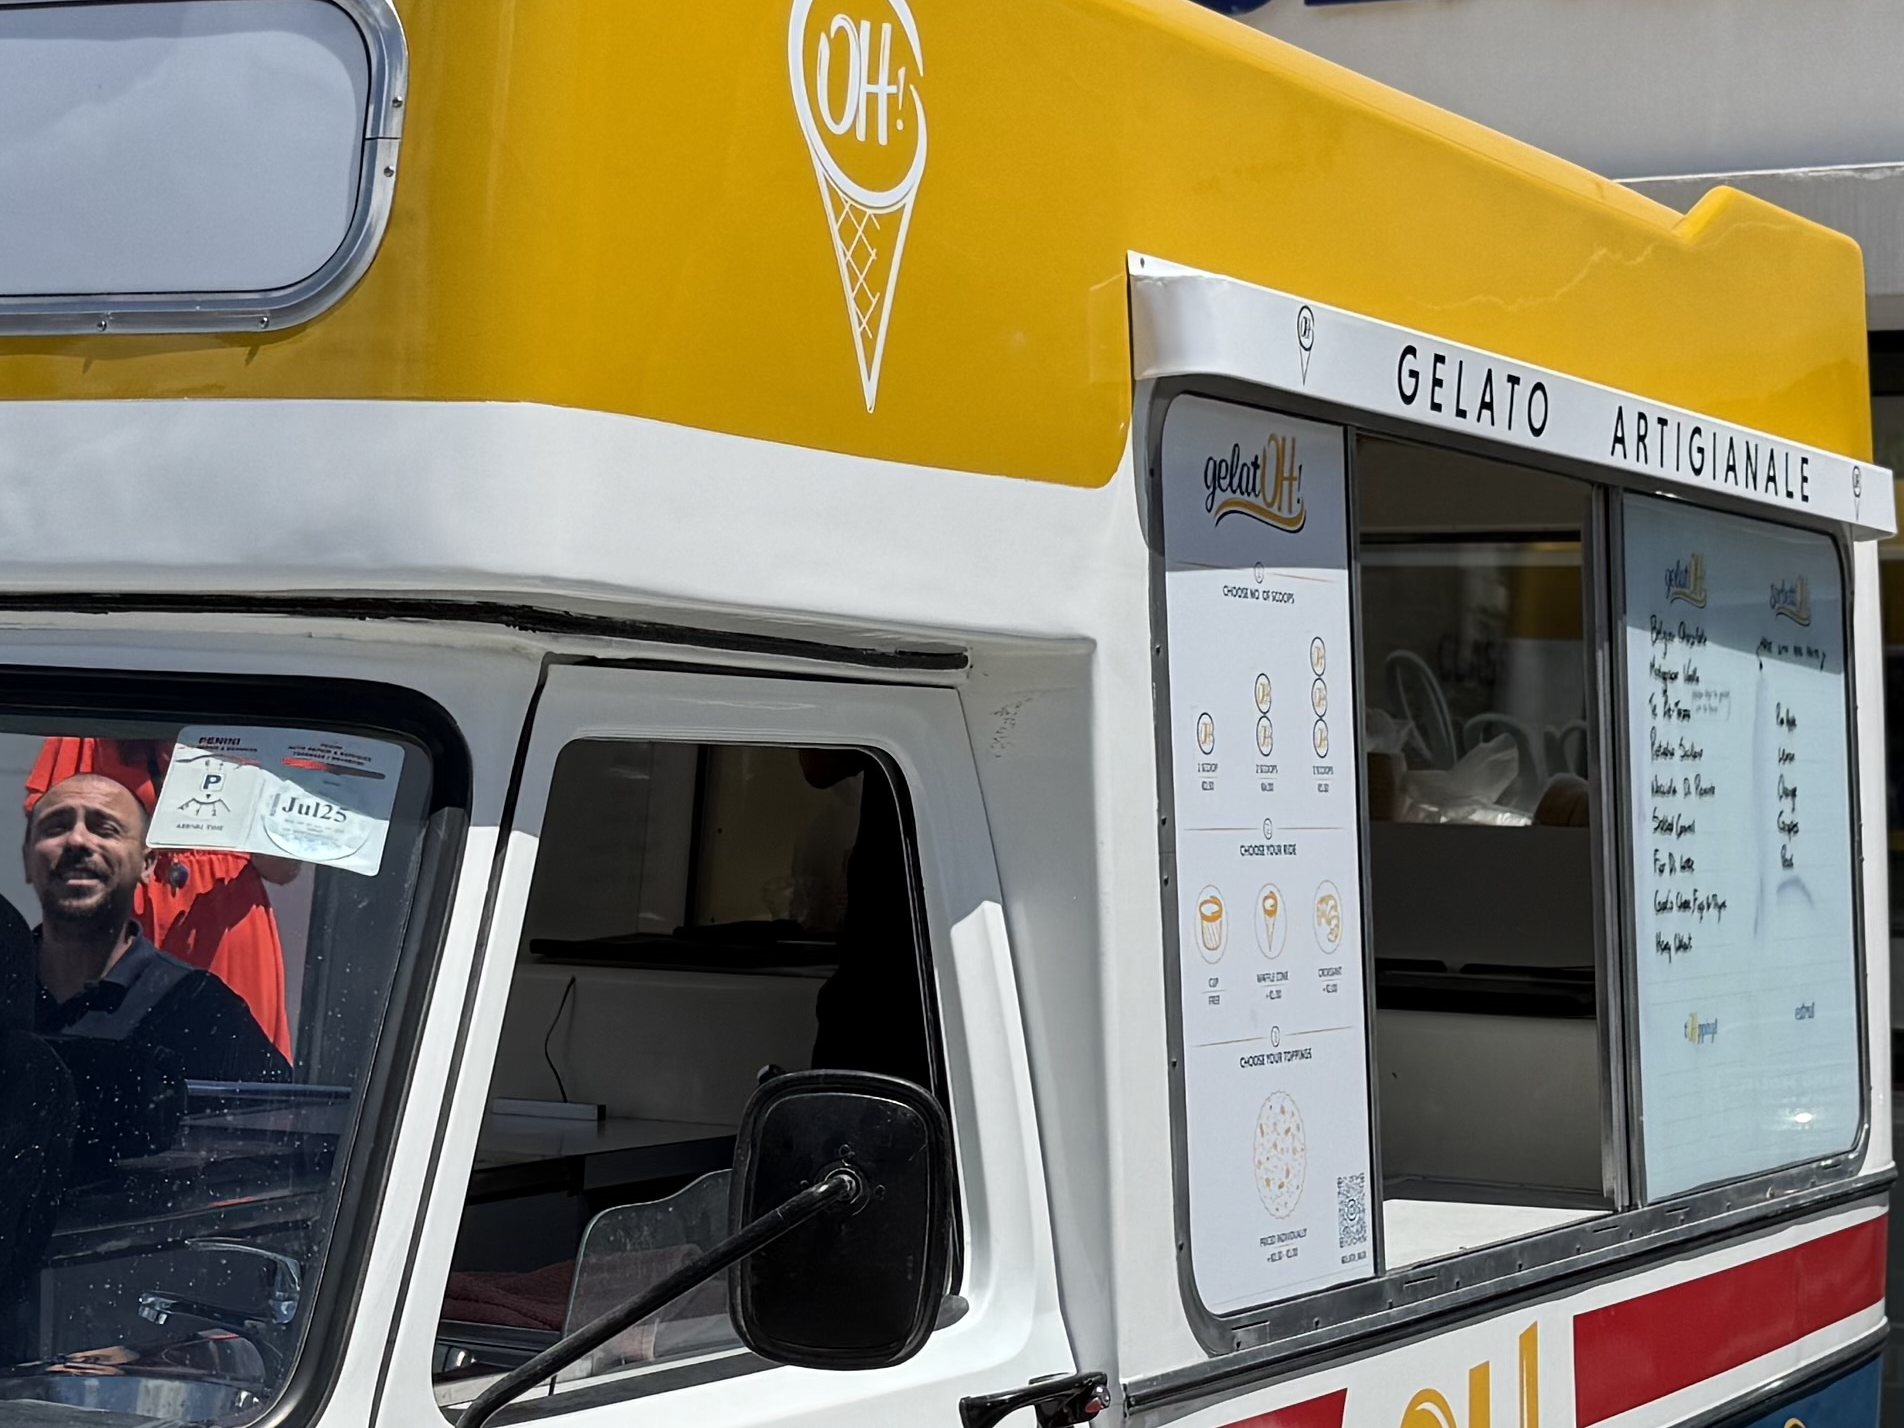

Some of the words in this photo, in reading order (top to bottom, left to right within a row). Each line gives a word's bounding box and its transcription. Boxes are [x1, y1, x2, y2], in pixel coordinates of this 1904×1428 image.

[817, 13, 906, 146] OH!
[1396, 344, 1549, 439] GELATO
[1610, 404, 1810, 503] ARTIGIANALE
[1203, 432, 1303, 517] gelatOH!
[202, 774, 222, 790] P
[282, 796, 349, 823] Jul25
